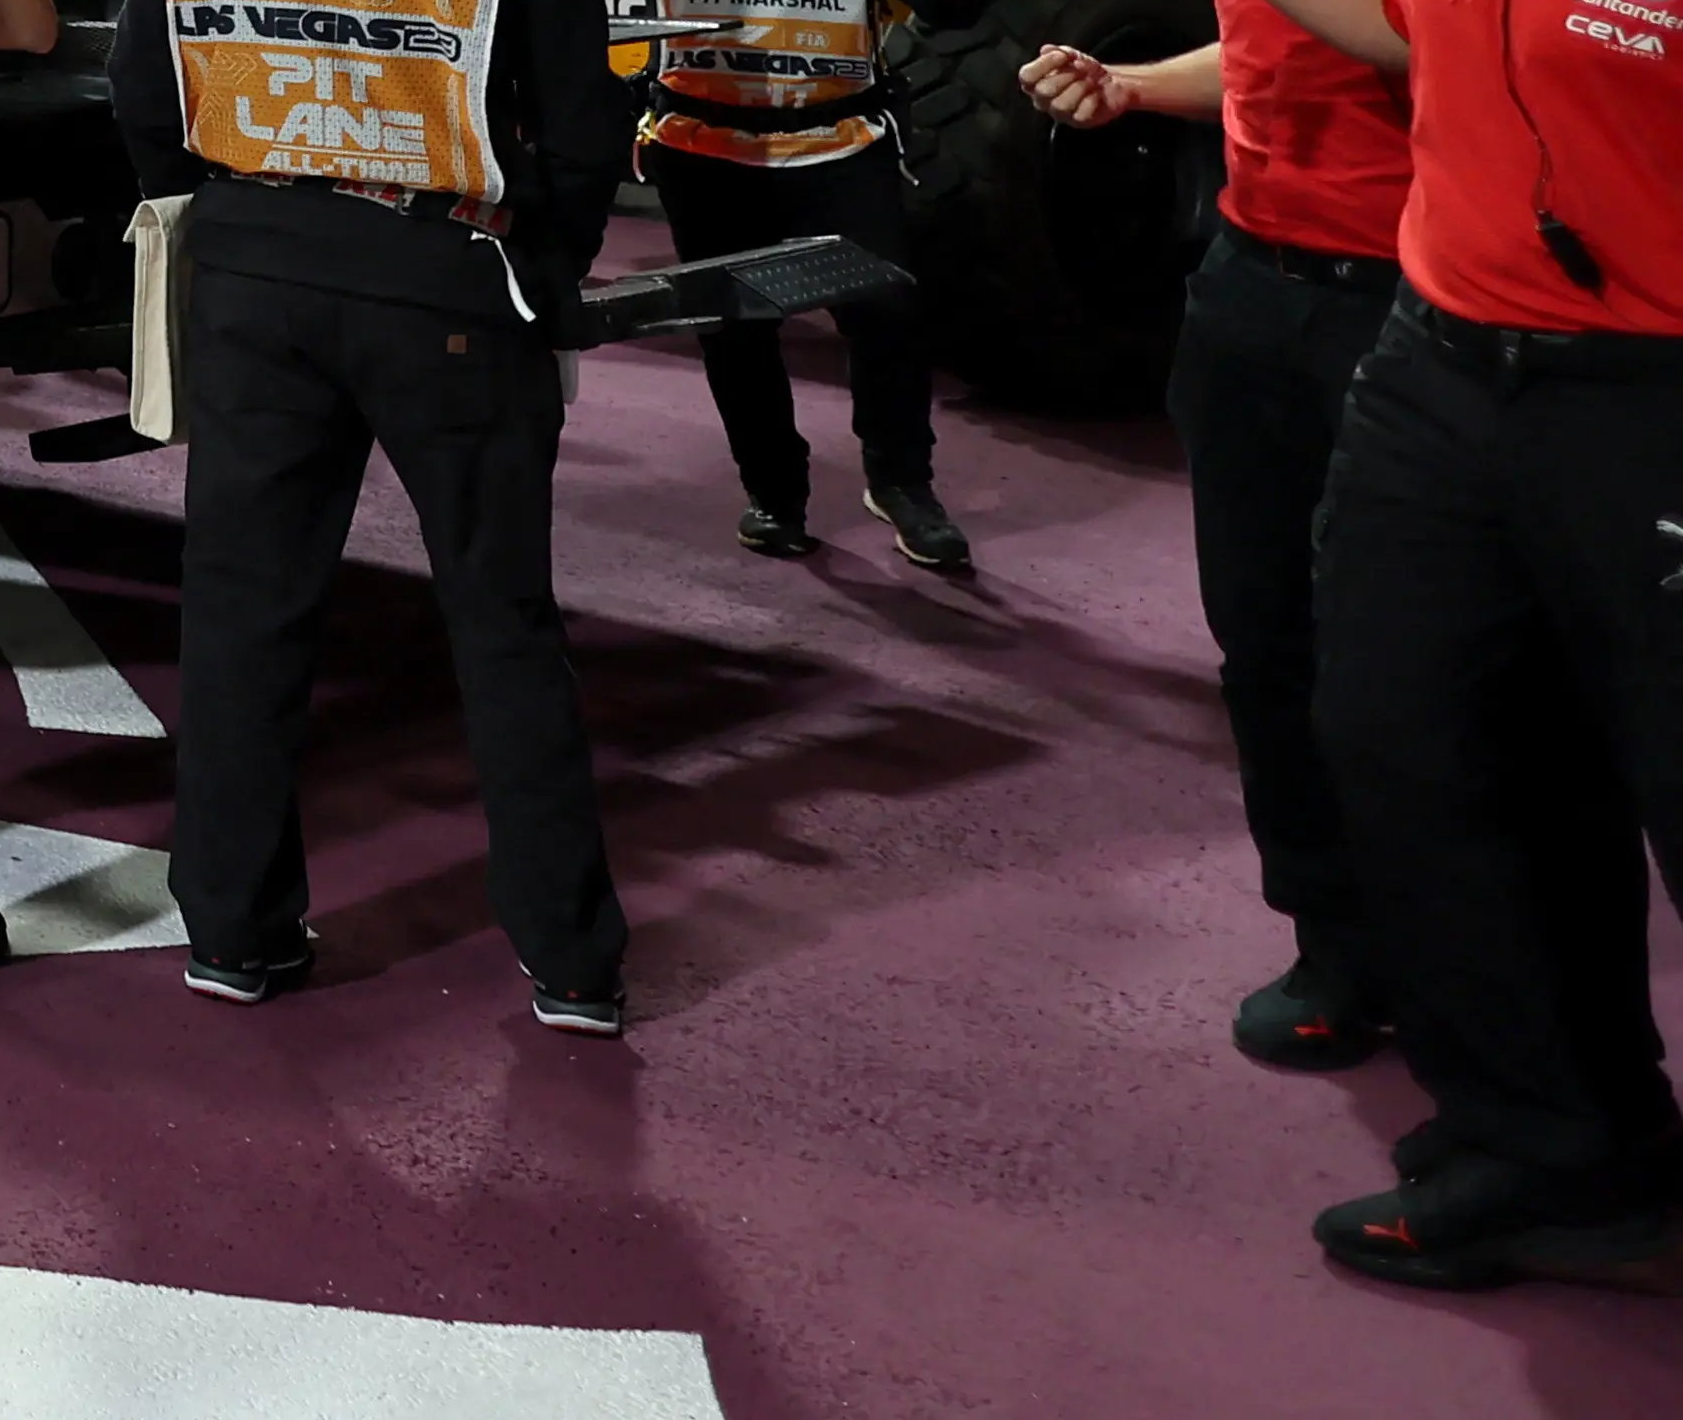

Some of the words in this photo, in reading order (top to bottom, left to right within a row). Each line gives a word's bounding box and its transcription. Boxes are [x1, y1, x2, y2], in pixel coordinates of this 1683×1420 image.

[243, 5, 406, 50] VEGAS
[260, 52, 383, 104] PIT
[235, 96, 426, 155] LANE
